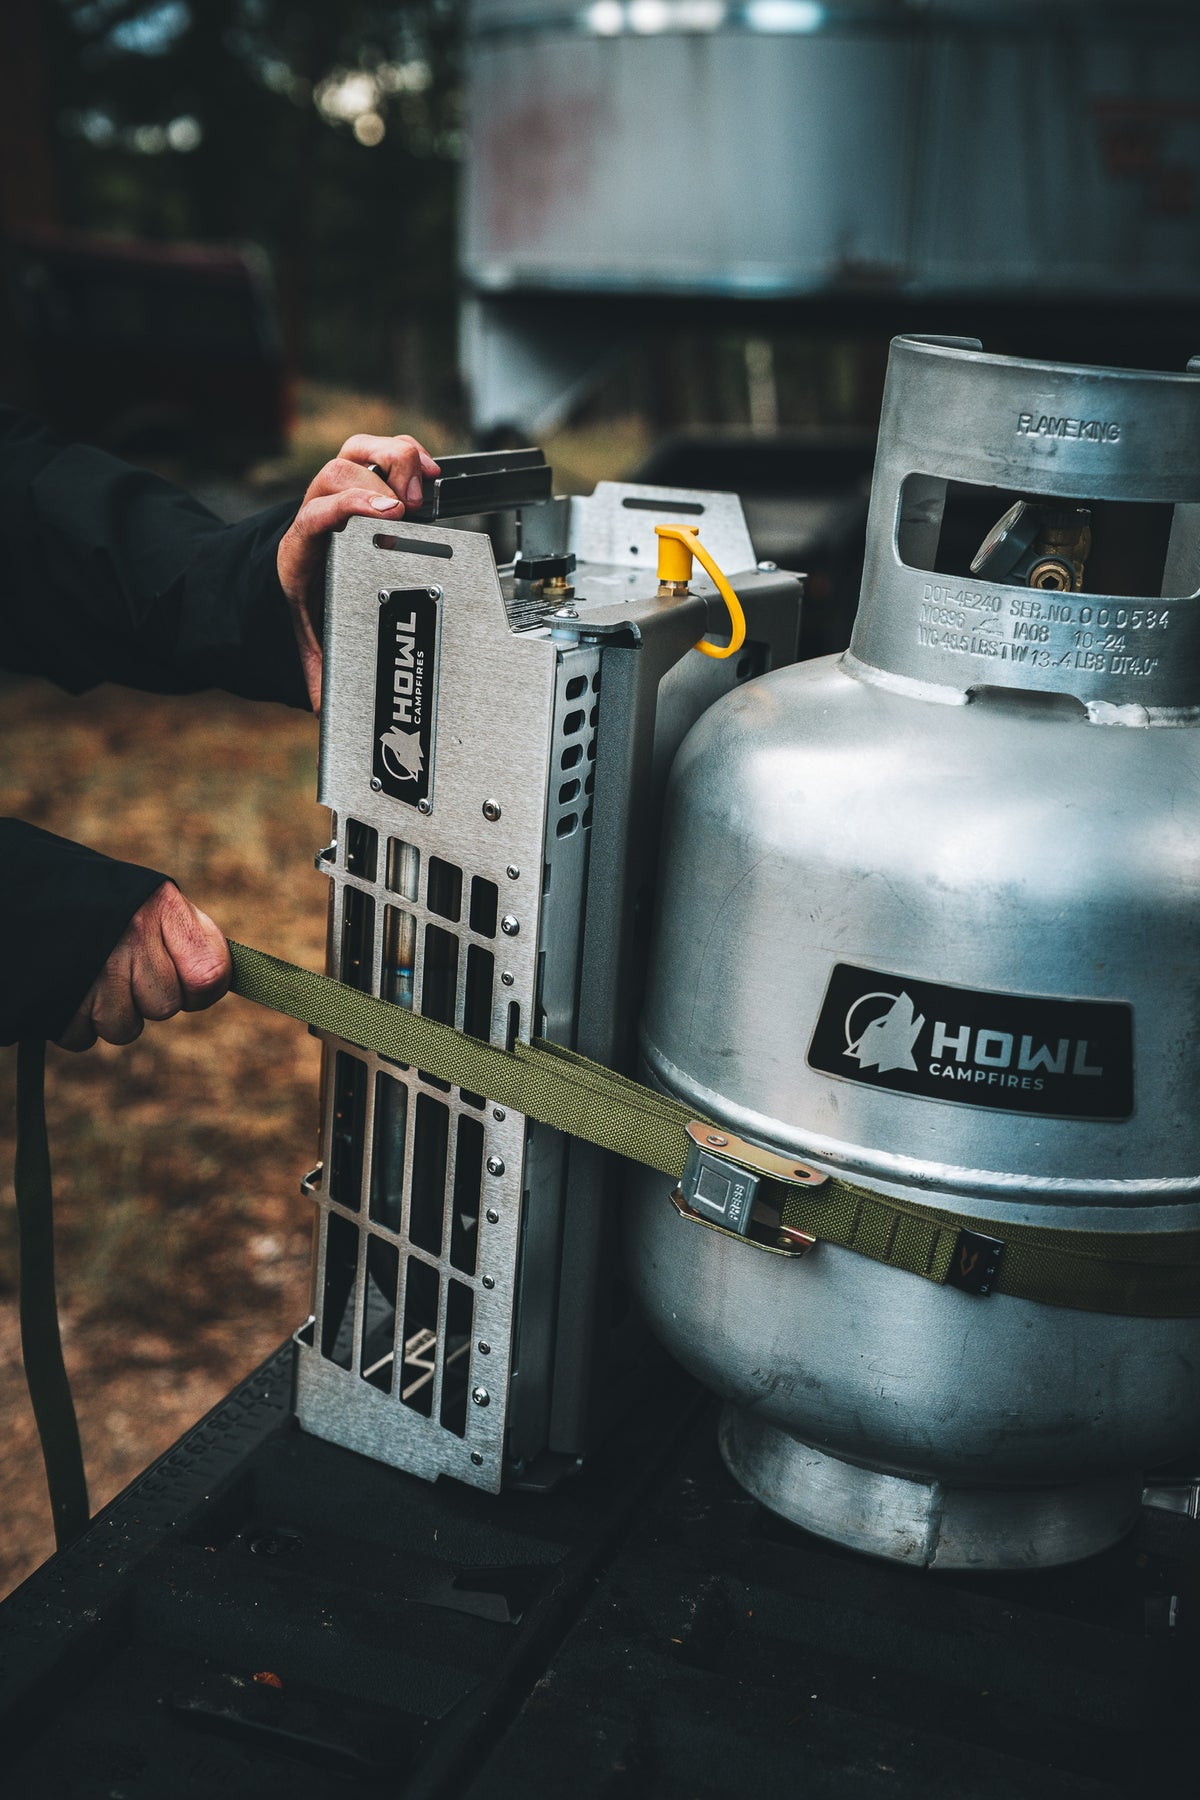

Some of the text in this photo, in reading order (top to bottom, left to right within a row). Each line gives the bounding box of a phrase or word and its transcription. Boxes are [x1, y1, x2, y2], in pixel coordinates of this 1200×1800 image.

[392, 612, 417, 723] HOWL
[414, 651, 425, 725] CAMPFIRES
[930, 1020, 1104, 1077] HOWL
[928, 1063, 1044, 1092] CAMPFIRES
[727, 1184, 745, 1222] PRESS
